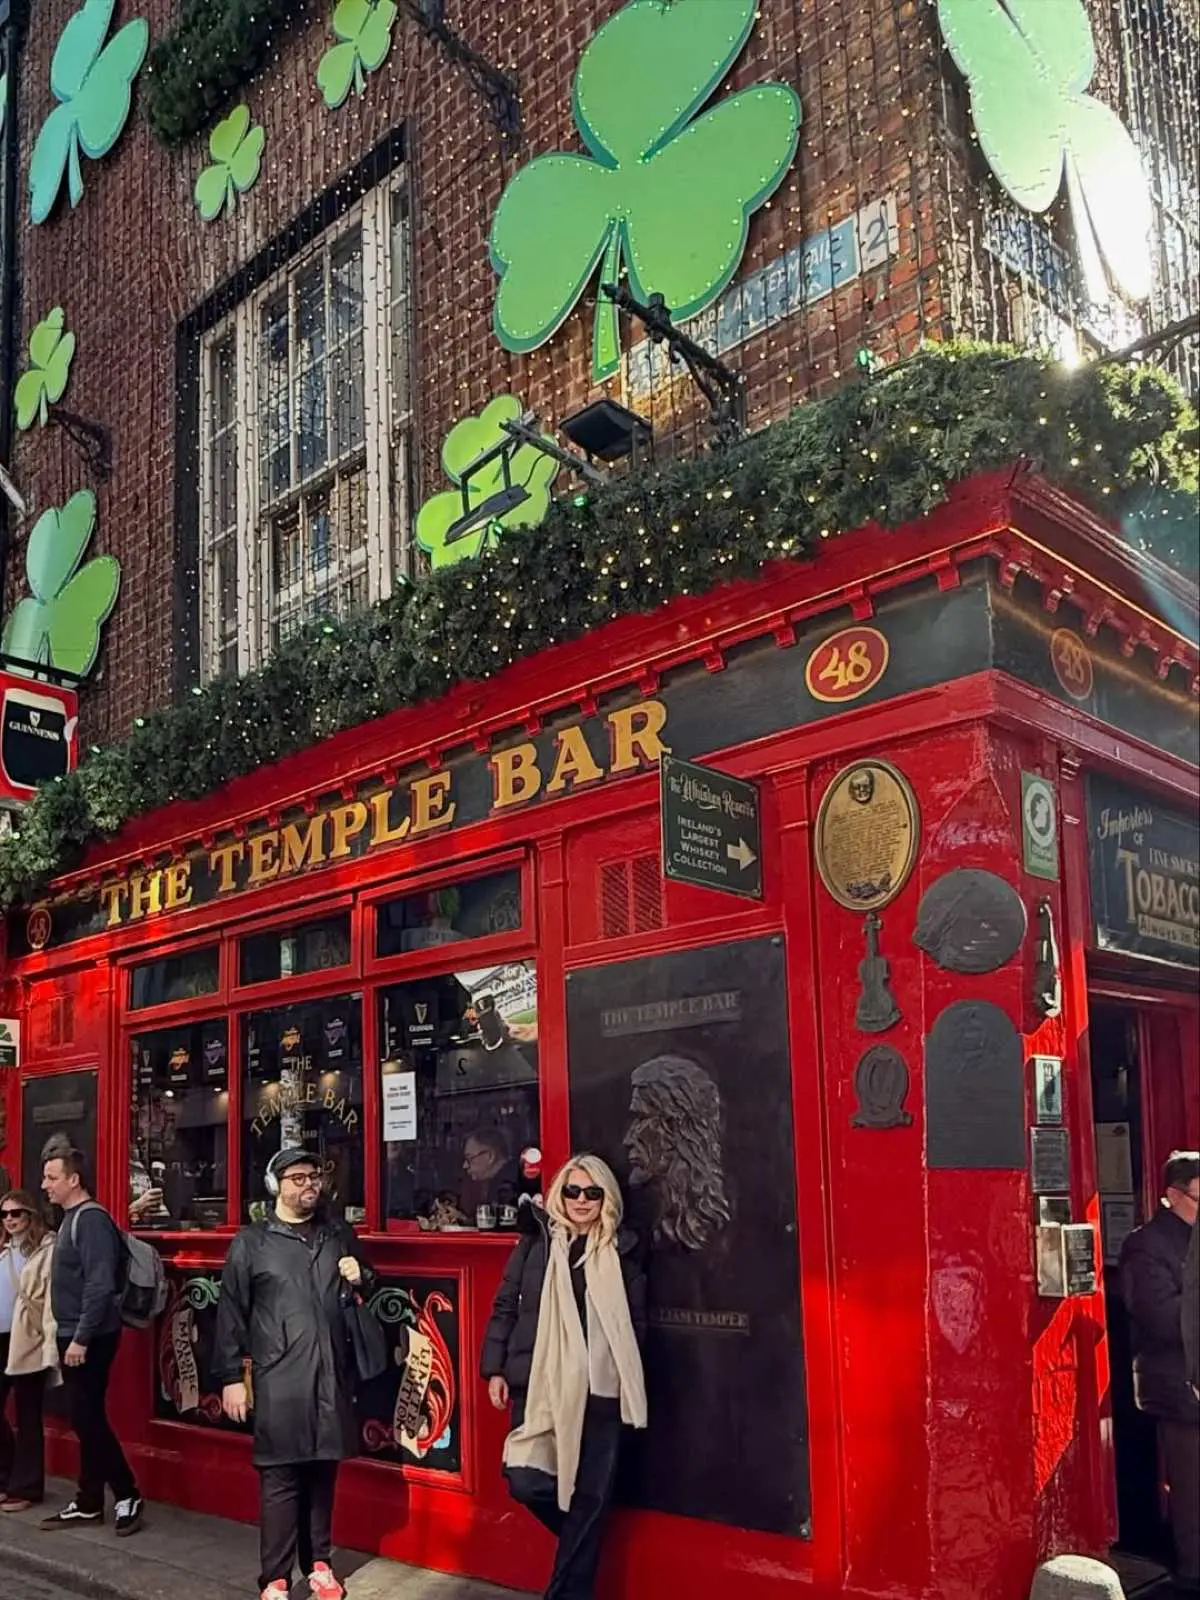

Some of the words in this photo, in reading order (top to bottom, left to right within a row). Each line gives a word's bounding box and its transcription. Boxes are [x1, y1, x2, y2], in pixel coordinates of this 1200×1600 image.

[865, 214, 888, 252] 2
[818, 640, 873, 690] 48
[1057, 636, 1085, 684] 48
[9, 721, 60, 741] GUINNESS
[101, 858, 193, 927] THE
[210, 771, 456, 892] TEMPLE
[491, 700, 673, 808] BAR
[678, 815, 722, 837] IRELAND'S
[680, 841, 720, 860] WHISKEY
[681, 829, 719, 848] LARGEST
[673, 851, 728, 876] COLLECTION
[601, 1010, 629, 1027] THE
[637, 998, 699, 1022] TEMPLE
[703, 990, 740, 1010] BAR
[290, 1056, 312, 1071] THE
[323, 1088, 358, 1133] BAR
[395, 1353, 421, 1432] EDITION
[405, 1348, 431, 1439] LIMITED
